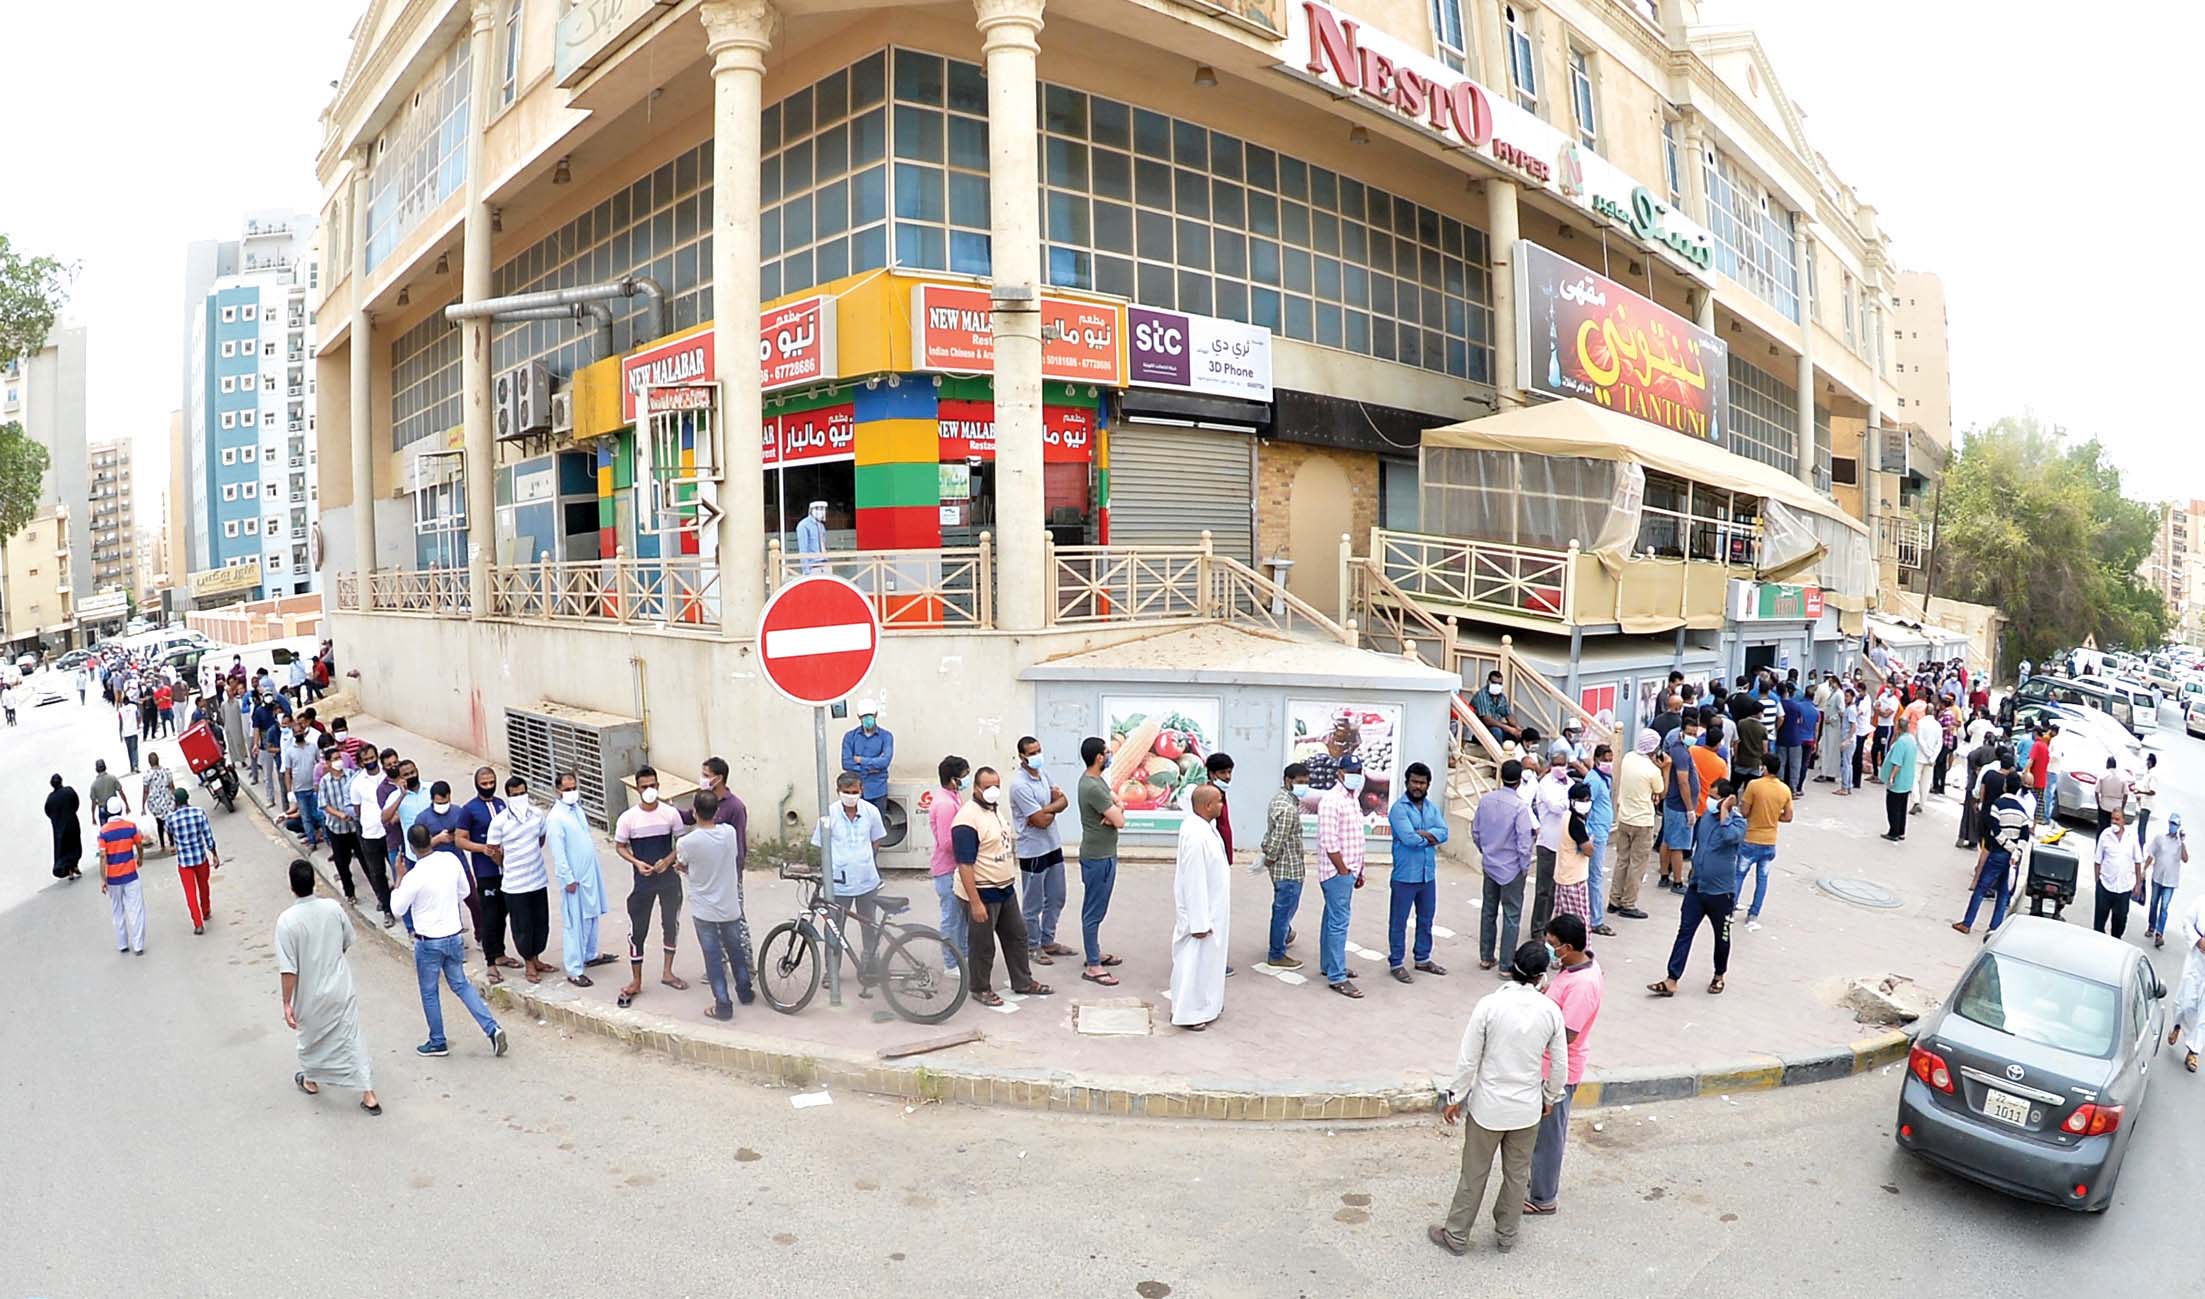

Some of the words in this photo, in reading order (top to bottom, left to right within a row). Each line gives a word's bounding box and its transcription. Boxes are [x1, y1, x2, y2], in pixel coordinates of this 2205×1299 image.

[1303, 2, 1493, 146] NESTO
[1492, 138, 1550, 181] HYPER
[1630, 186, 1713, 270] نستو
[1560, 276, 1606, 307] مقهى
[776, 310, 801, 329] مطعم
[929, 307, 959, 331] NEW
[961, 310, 993, 333] MALA
[1079, 314, 1105, 326] مطعم
[777, 313, 815, 359] نيو
[1084, 326, 1111, 350] نيو
[1136, 320, 1182, 356] stc
[1212, 339, 1229, 356] دي
[1577, 303, 1706, 406] تنتوني
[628, 364, 651, 395] NEW
[652, 347, 705, 385] MALABAR
[1209, 360, 1222, 373] 3D
[1224, 363, 1254, 378] Phone
[828, 412, 848, 426] مطعم
[1063, 412, 1086, 424] مطعم
[1620, 383, 1707, 439] TANTUNI
[785, 422, 825, 454] مالبار
[829, 416, 854, 448] نيو
[938, 421, 959, 438] NEW
[961, 421, 995, 439] MALAB
[1063, 426, 1087, 448] نيو
[1996, 1094, 2006, 1103] 22
[1995, 1105, 2021, 1122] 1011
